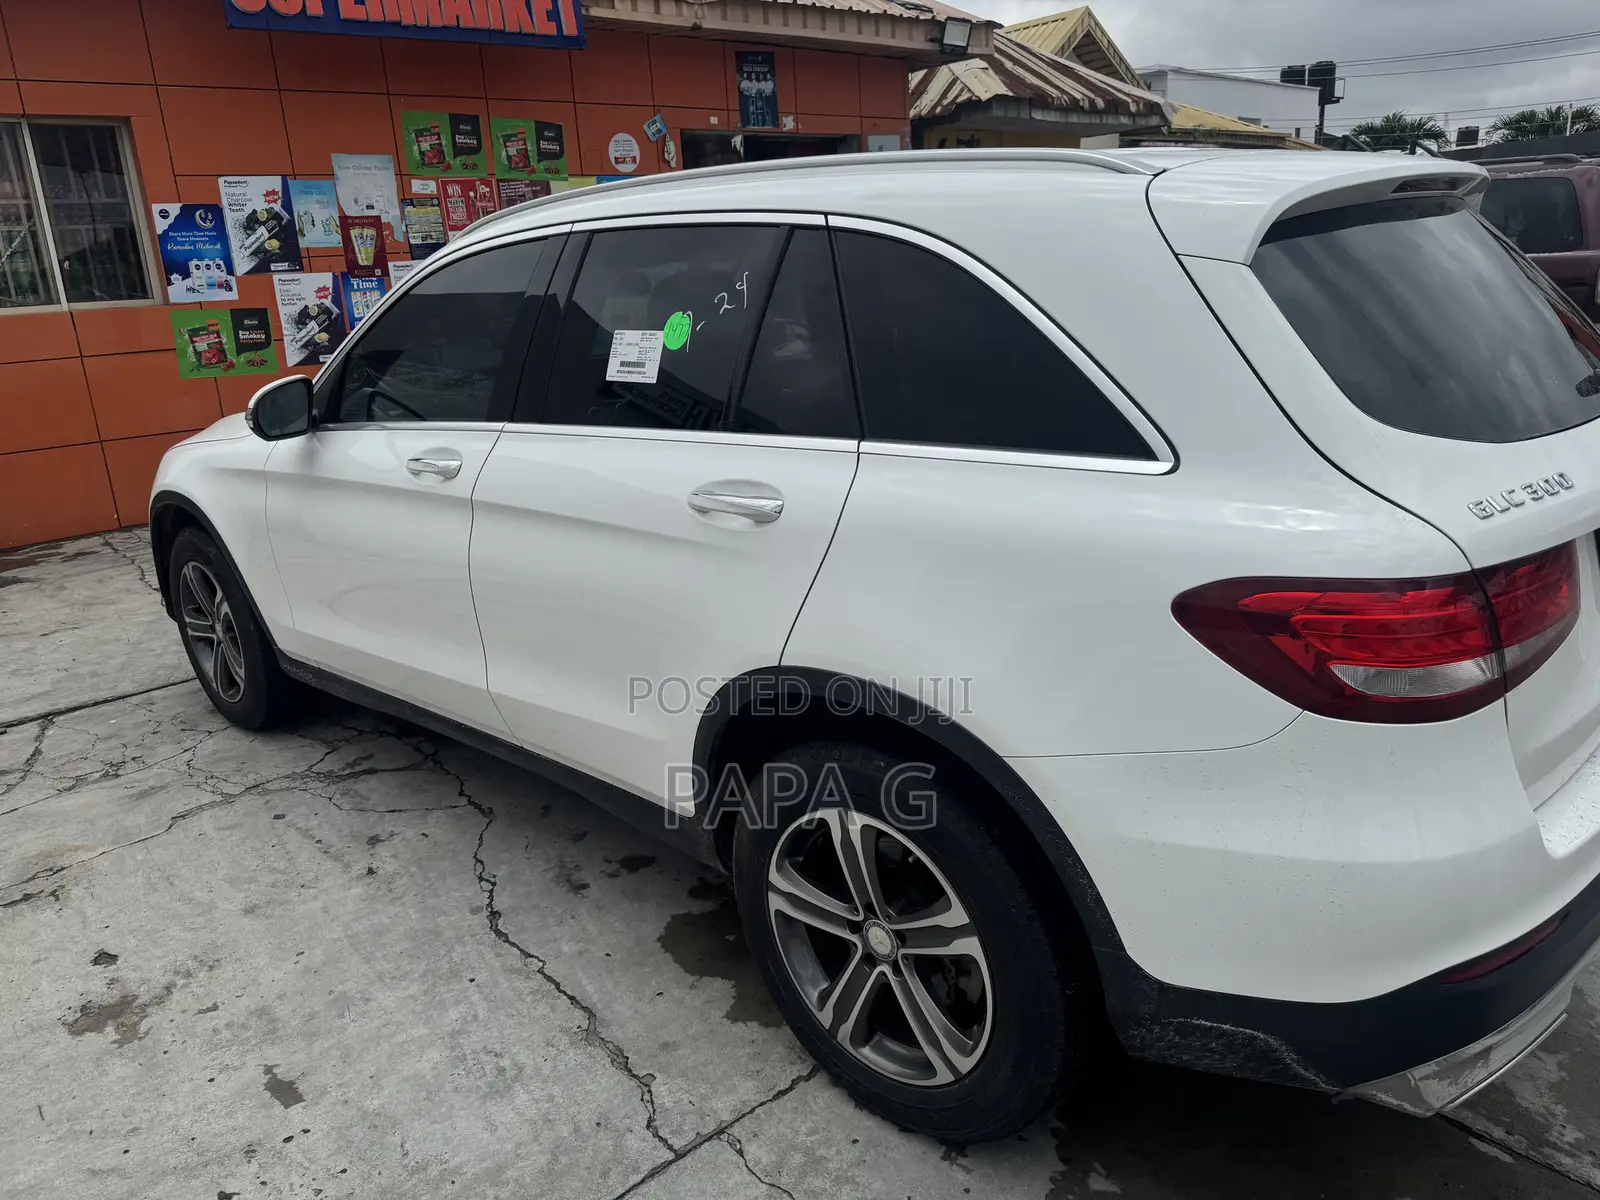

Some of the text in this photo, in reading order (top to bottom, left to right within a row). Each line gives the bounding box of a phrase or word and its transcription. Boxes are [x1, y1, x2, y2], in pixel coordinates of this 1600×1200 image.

[229, 0, 578, 36] MARKET
[446, 184, 461, 196] WIN
[351, 280, 378, 289] Time
[1467, 472, 1574, 520] GLC 300
